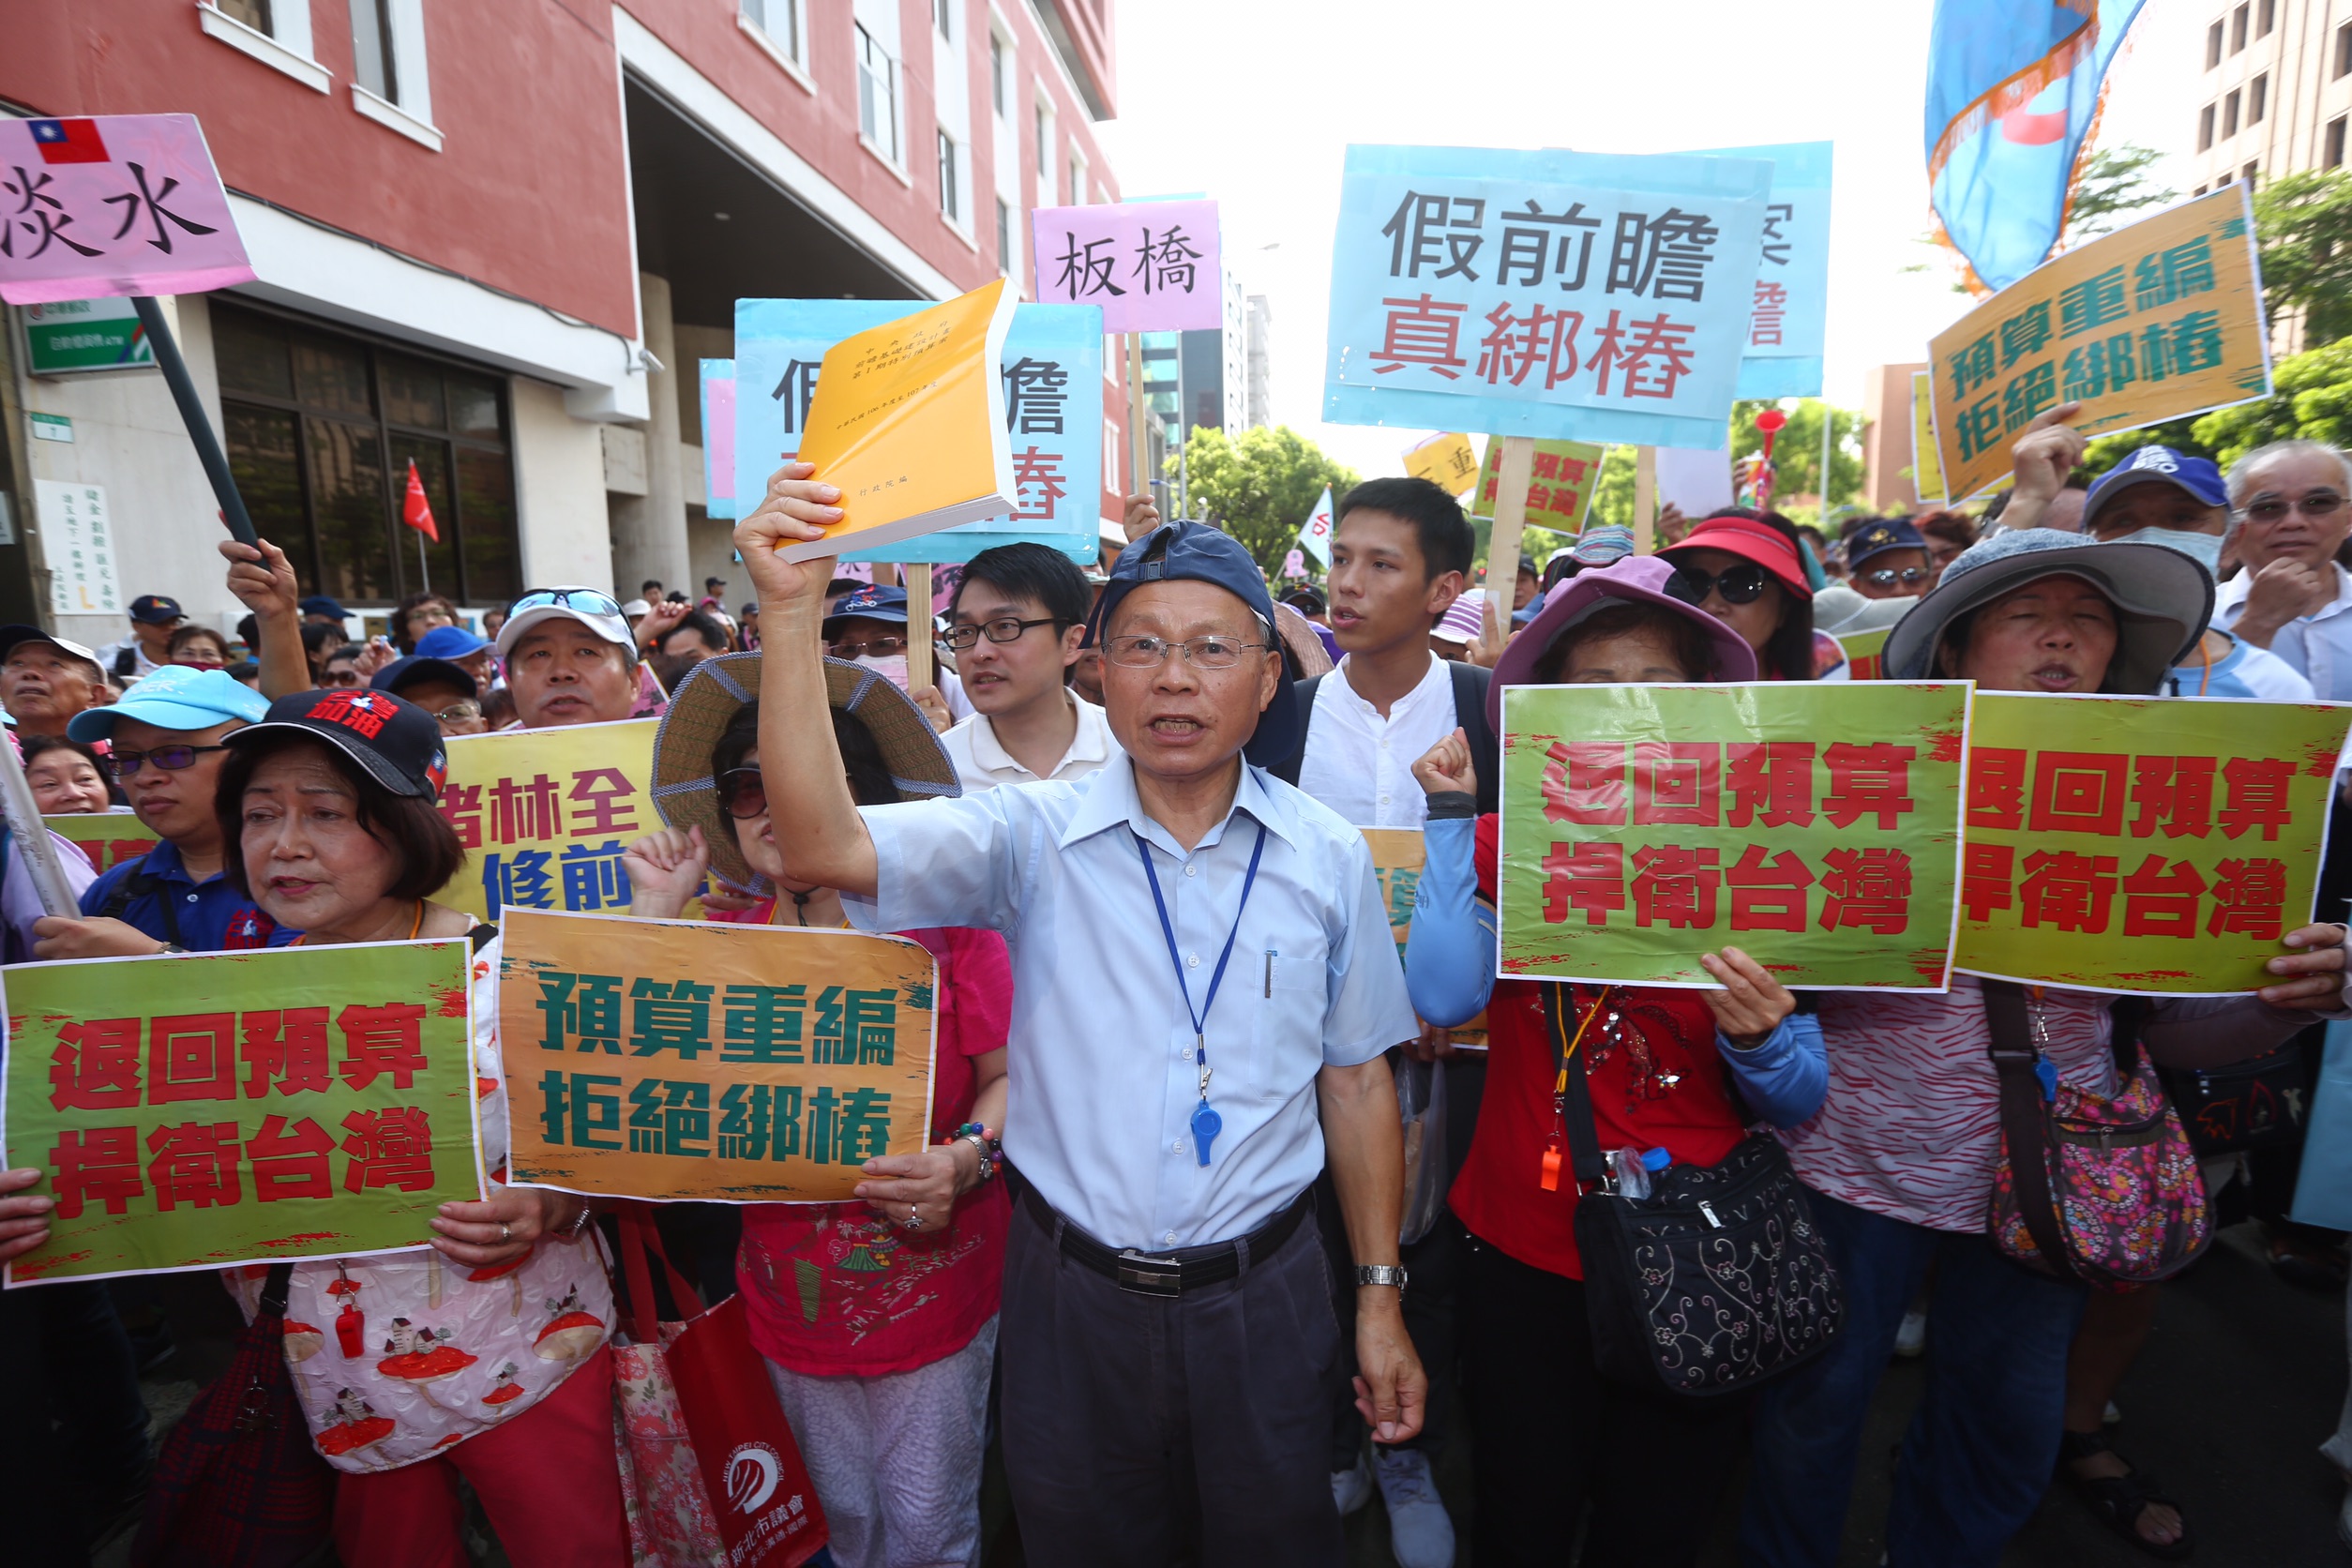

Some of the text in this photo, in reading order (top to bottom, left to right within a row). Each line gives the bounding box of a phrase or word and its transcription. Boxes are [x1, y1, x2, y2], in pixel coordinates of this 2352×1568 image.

[1055, 224, 1203, 301] 板橋
[1381, 189, 1720, 302] 假前瞻
[1368, 293, 1696, 400] 真綁樁
[1950, 234, 2217, 402] 預算重編
[304, 702, 385, 740] 加油
[1541, 742, 1916, 830] 退回預算
[1541, 841, 1913, 935] 捍衛台灣
[49, 1003, 429, 1113] 退回預算
[535, 971, 898, 1066] 預算重編
[49, 1106, 435, 1220] 捍衛台灣
[731, 1494, 804, 1568] 新北市議會
